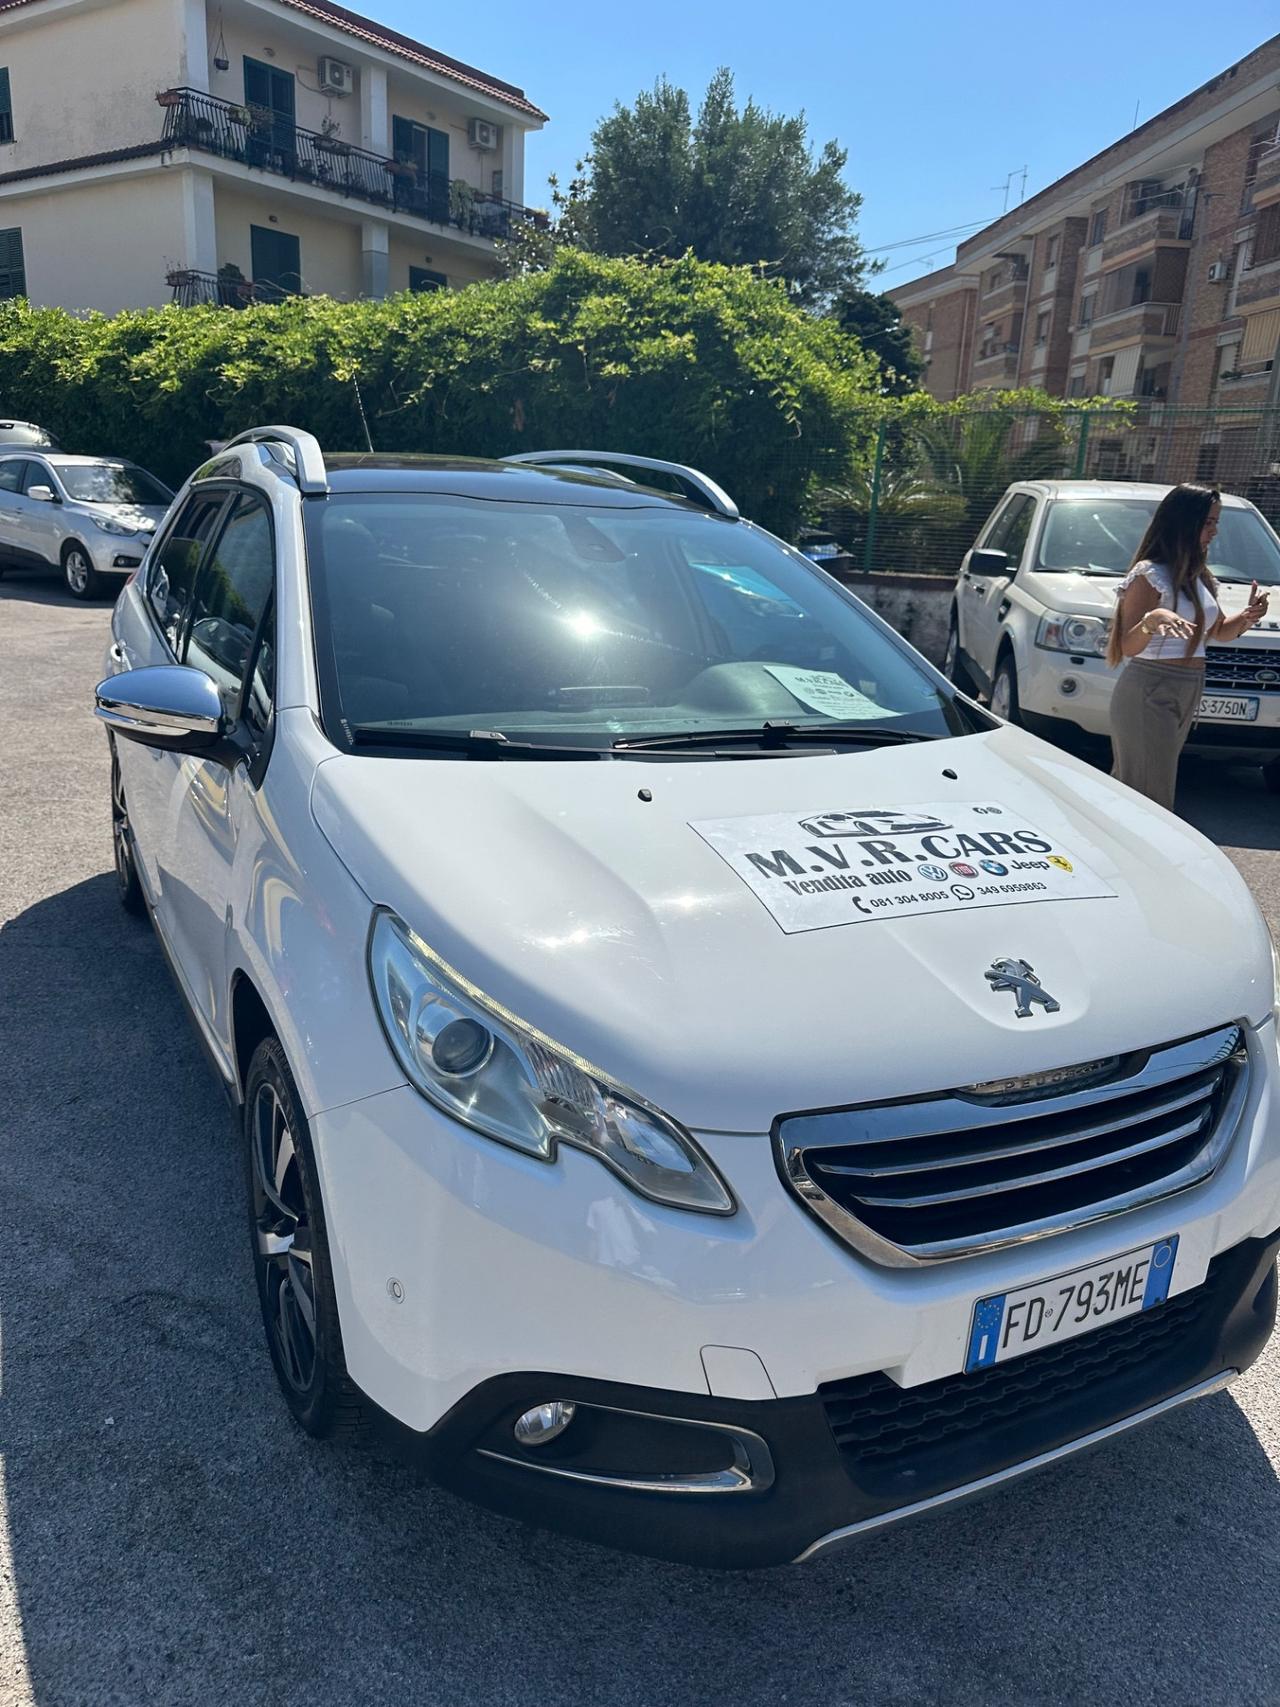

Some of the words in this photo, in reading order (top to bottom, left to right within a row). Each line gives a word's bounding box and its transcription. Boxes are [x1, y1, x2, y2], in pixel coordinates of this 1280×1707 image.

[744, 830, 1052, 878] M.V.R.CARS
[1011, 860, 1050, 871] Jeep
[783, 872, 867, 895] Vendita
[865, 869, 912, 886] auto
[977, 885, 999, 895] 349
[870, 897, 894, 908] 081
[894, 894, 918, 905] 304
[918, 891, 949, 901] 8005
